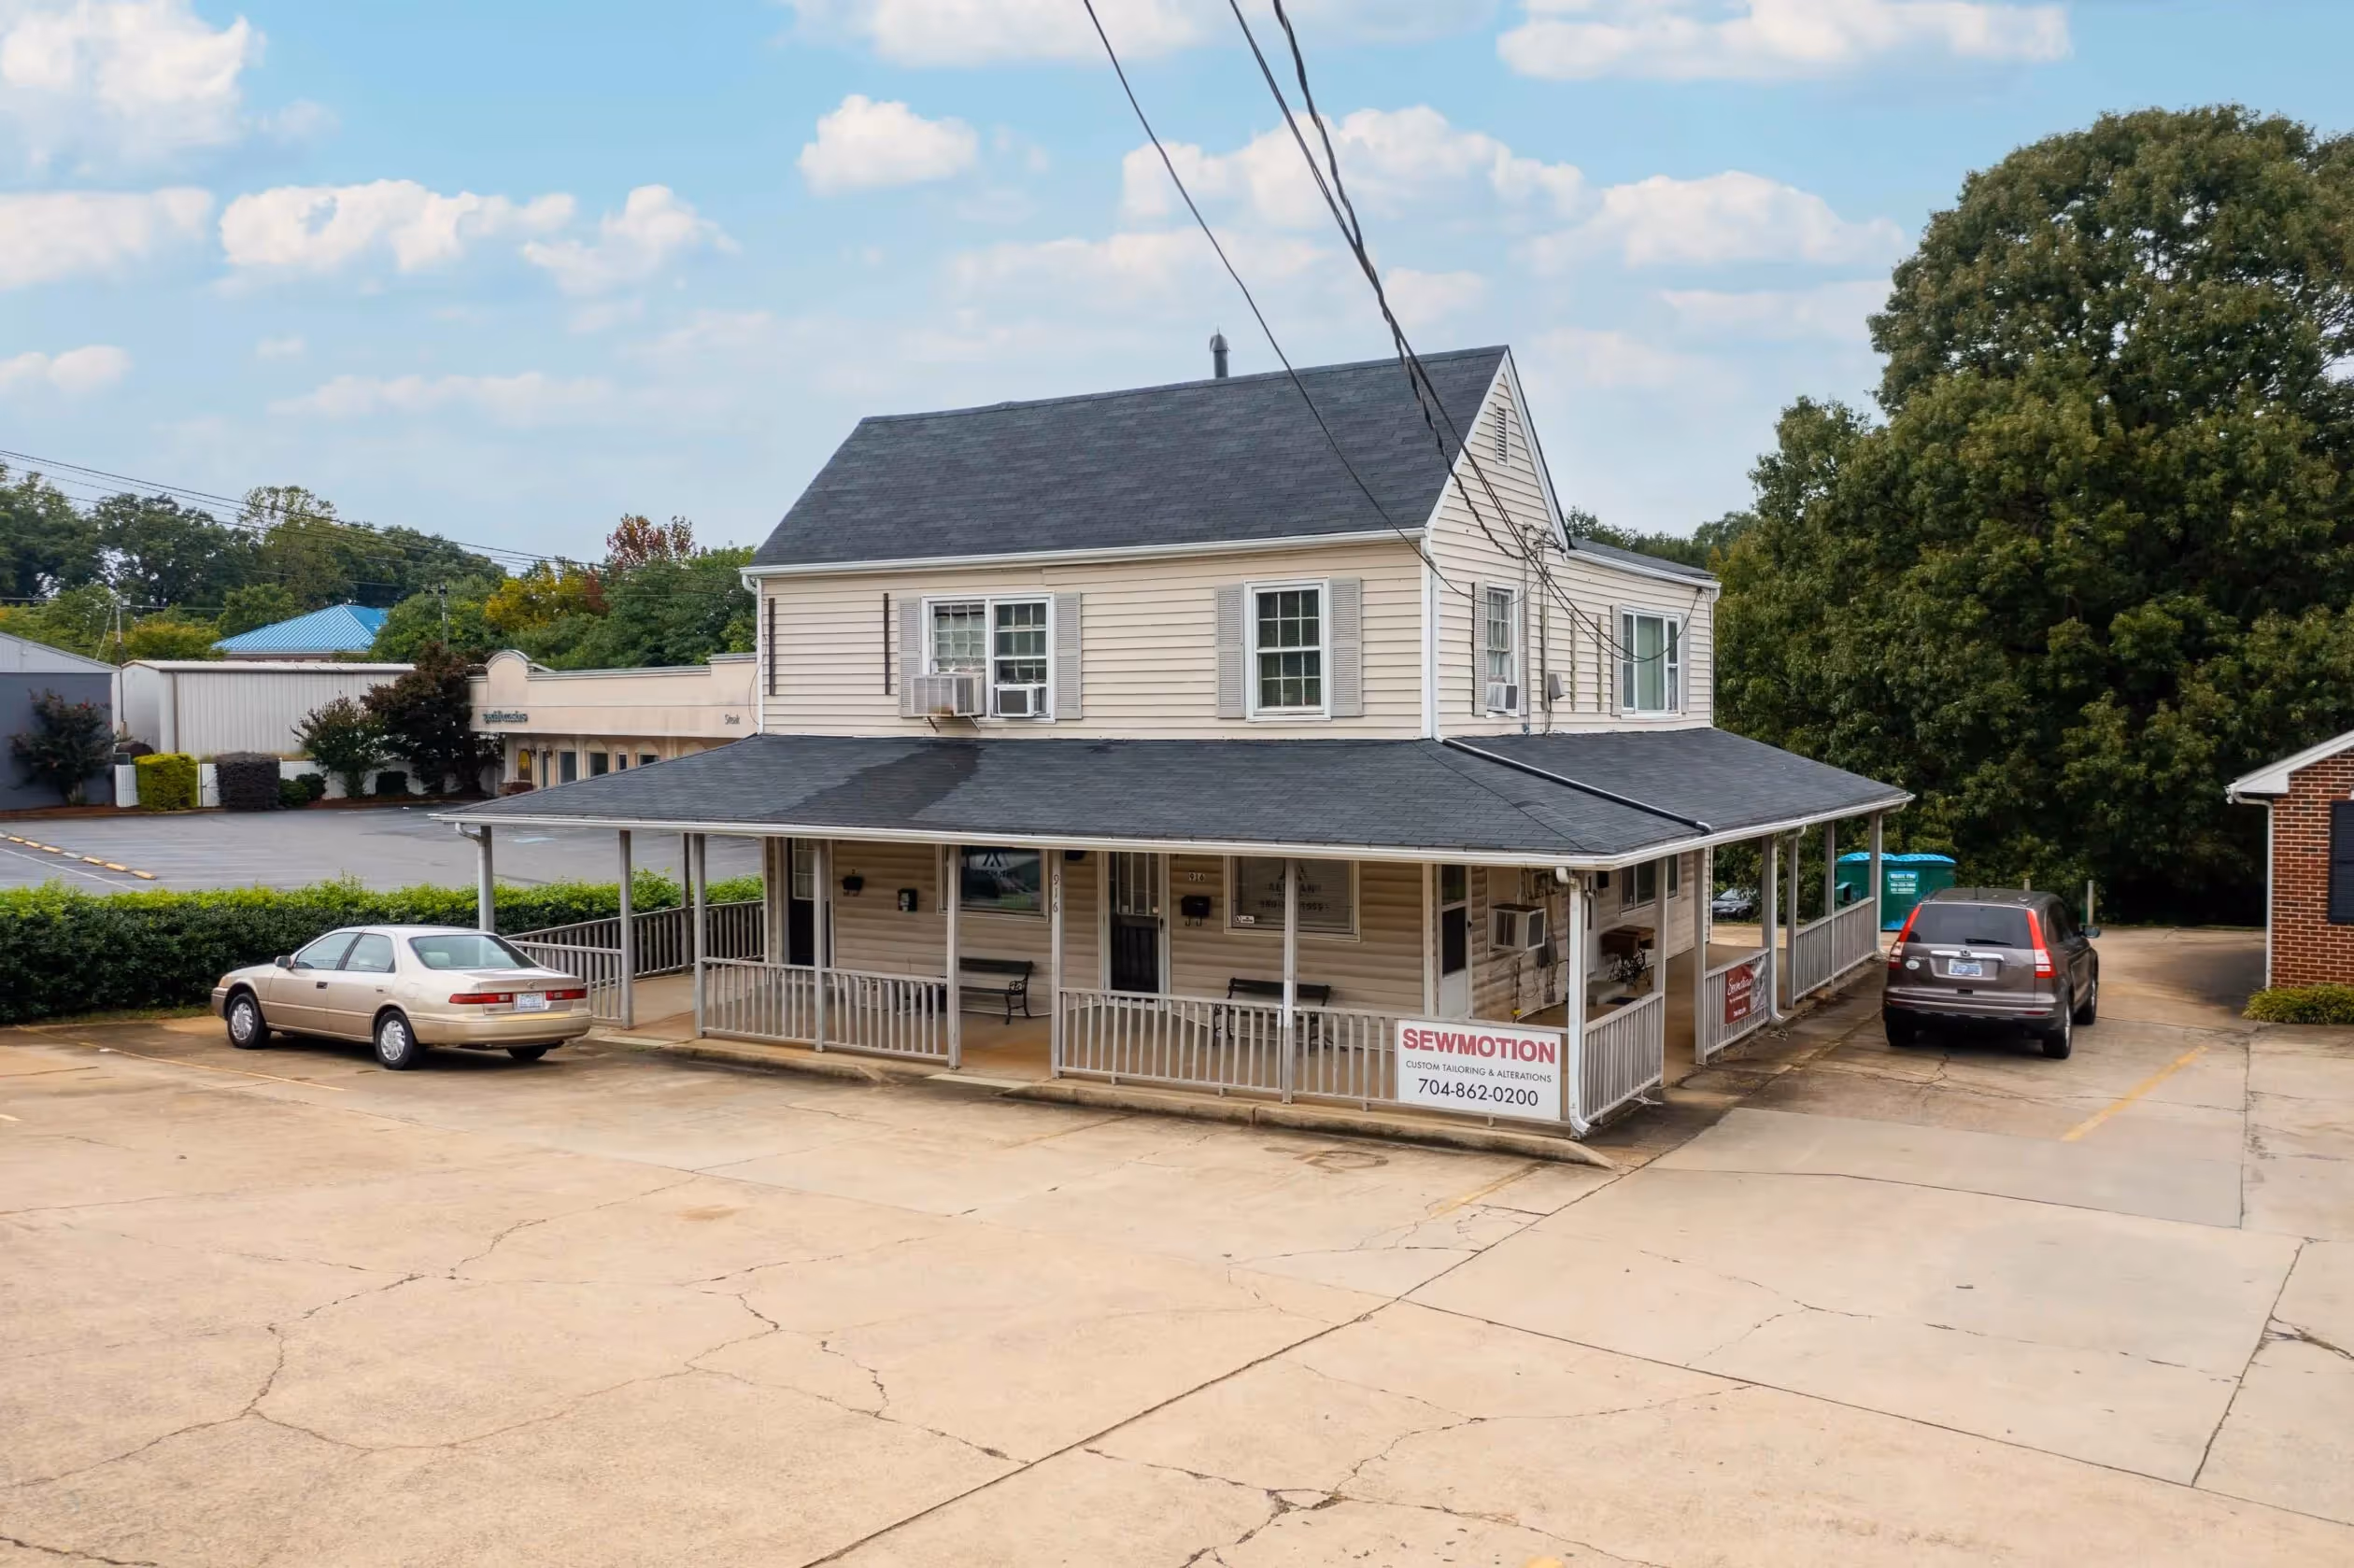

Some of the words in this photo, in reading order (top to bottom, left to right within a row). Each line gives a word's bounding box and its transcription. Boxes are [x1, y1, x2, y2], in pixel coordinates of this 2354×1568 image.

[1188, 871, 1205, 883] 916
[1052, 873, 1061, 913] 916
[1402, 1028, 1555, 1065] SEWMOTION
[1406, 1060, 1440, 1072] CUSTOM
[1442, 1063, 1486, 1077] TAILORING
[1496, 1070, 1553, 1083] ALTERATIONS
[1418, 1078, 1539, 1107] 704-862-0200
